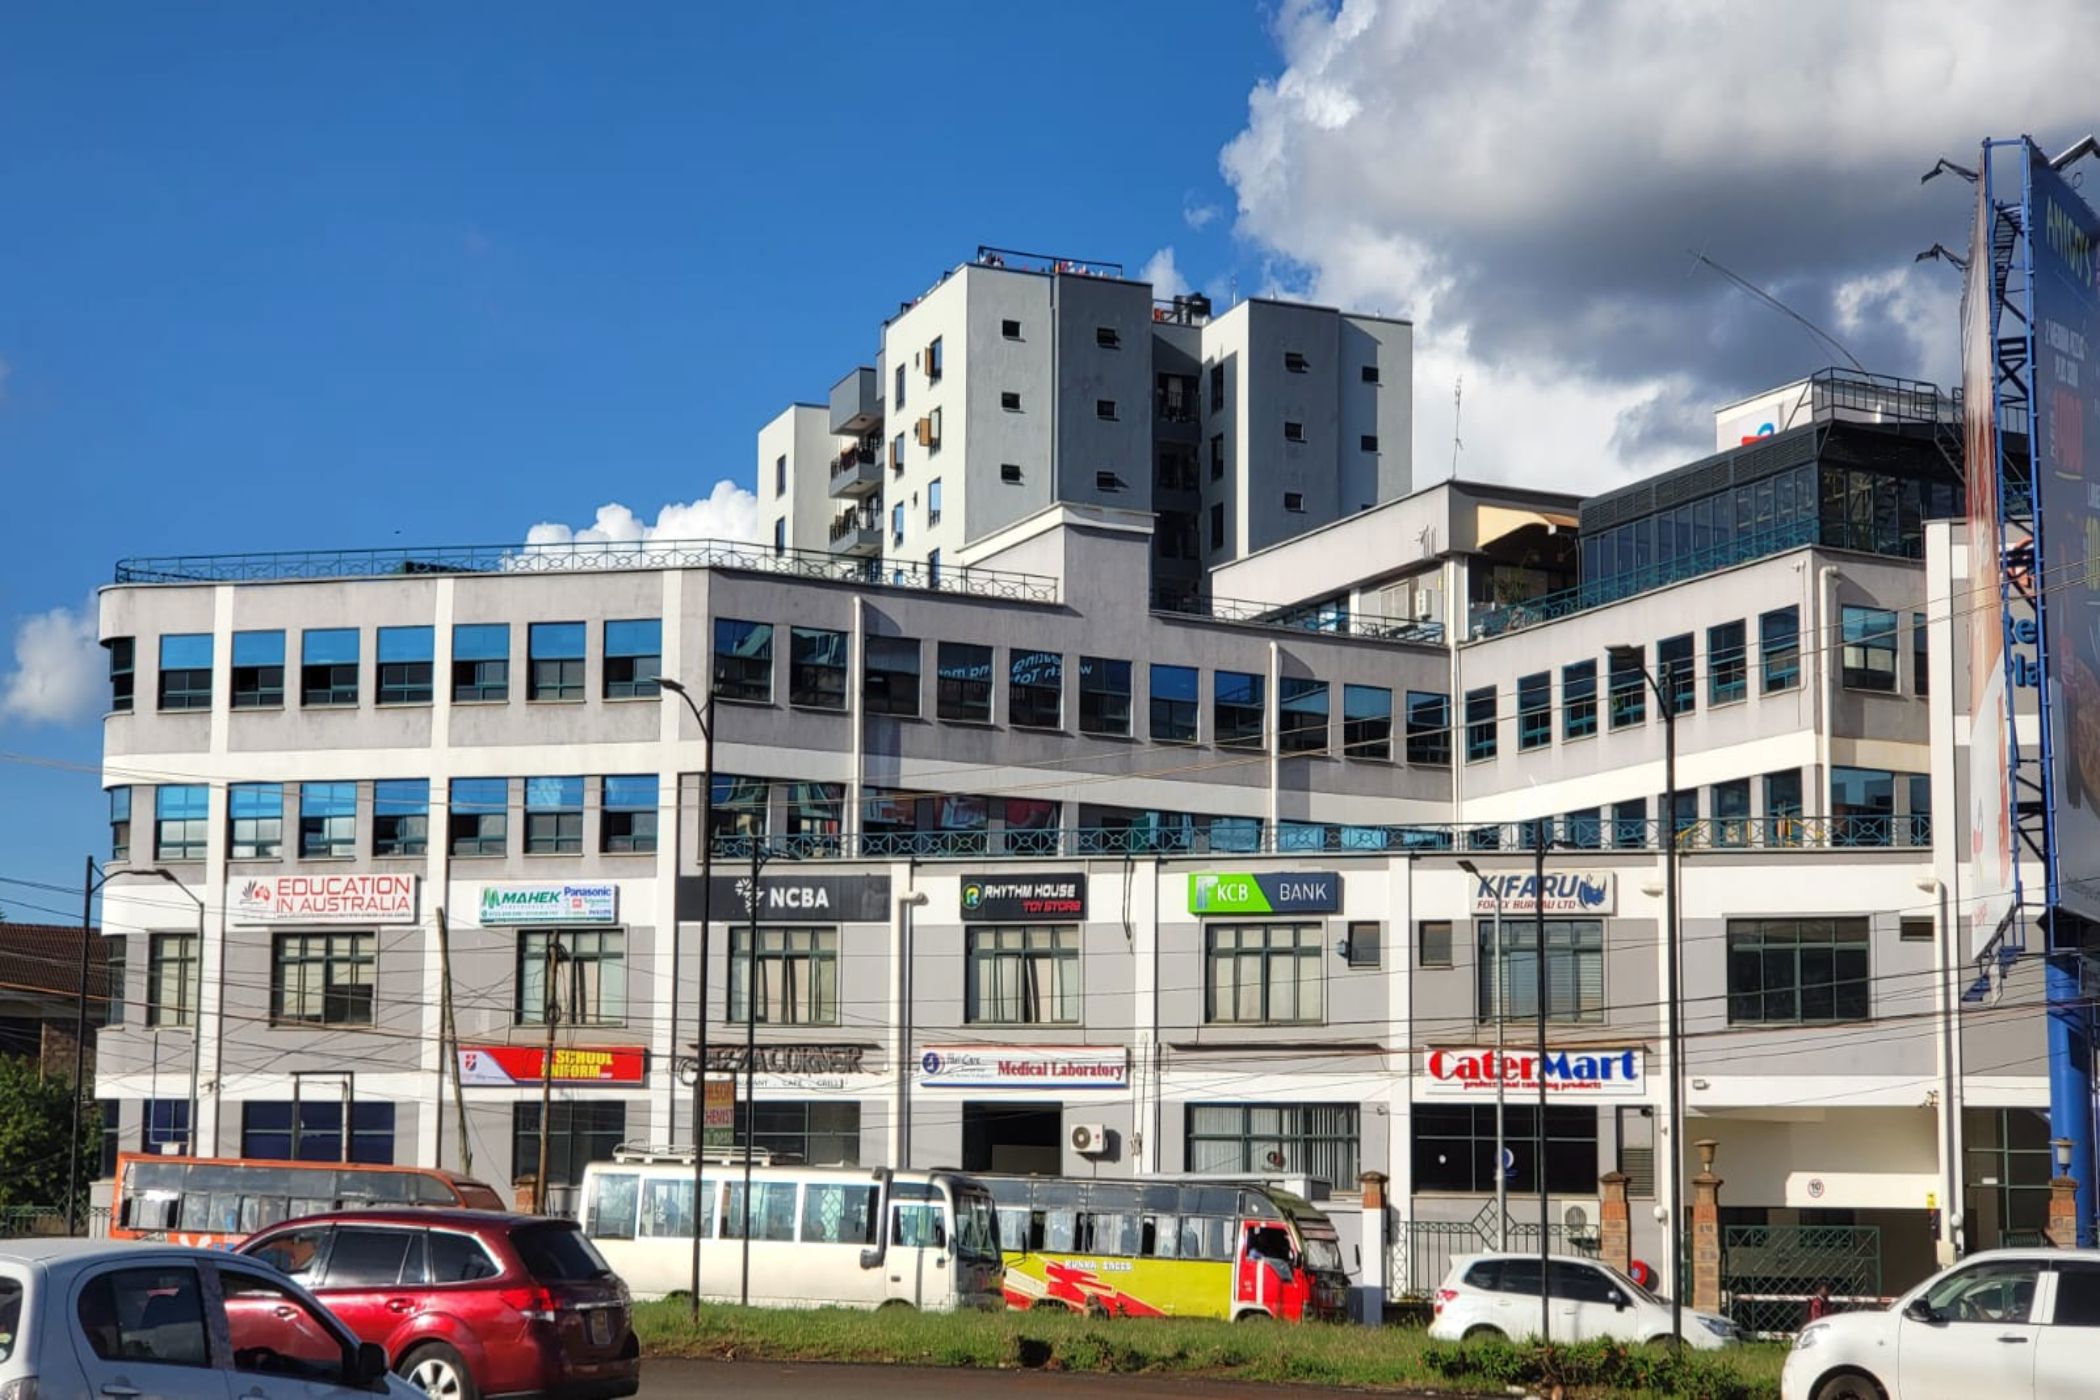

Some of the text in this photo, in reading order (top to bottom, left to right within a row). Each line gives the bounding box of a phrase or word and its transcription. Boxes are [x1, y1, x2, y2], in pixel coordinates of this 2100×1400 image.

[277, 876, 411, 896] EDUCATION
[564, 886, 611, 897] Panasonic
[985, 883, 1076, 898] RHYTHM HOUSE
[1217, 882, 1328, 902] KCB BANK
[1477, 874, 1579, 898] KIFARU
[276, 896, 411, 913] IN AUSTRALIA
[502, 890, 561, 904] MAHEK
[770, 887, 829, 908] NCBA
[1513, 900, 1555, 910] BURAU
[1557, 900, 1576, 910] LTD
[1043, 900, 1081, 912] STORE
[555, 1049, 613, 1065] SCHOOL
[1429, 1048, 1639, 1081] CaterMart
[998, 1060, 1047, 1076] Medical
[1051, 1060, 1125, 1080] Laboratory
[1464, 1080, 1520, 1090] professonal
[1522, 1080, 1559, 1091] cateng
[706, 1108, 734, 1125] HEMIST
